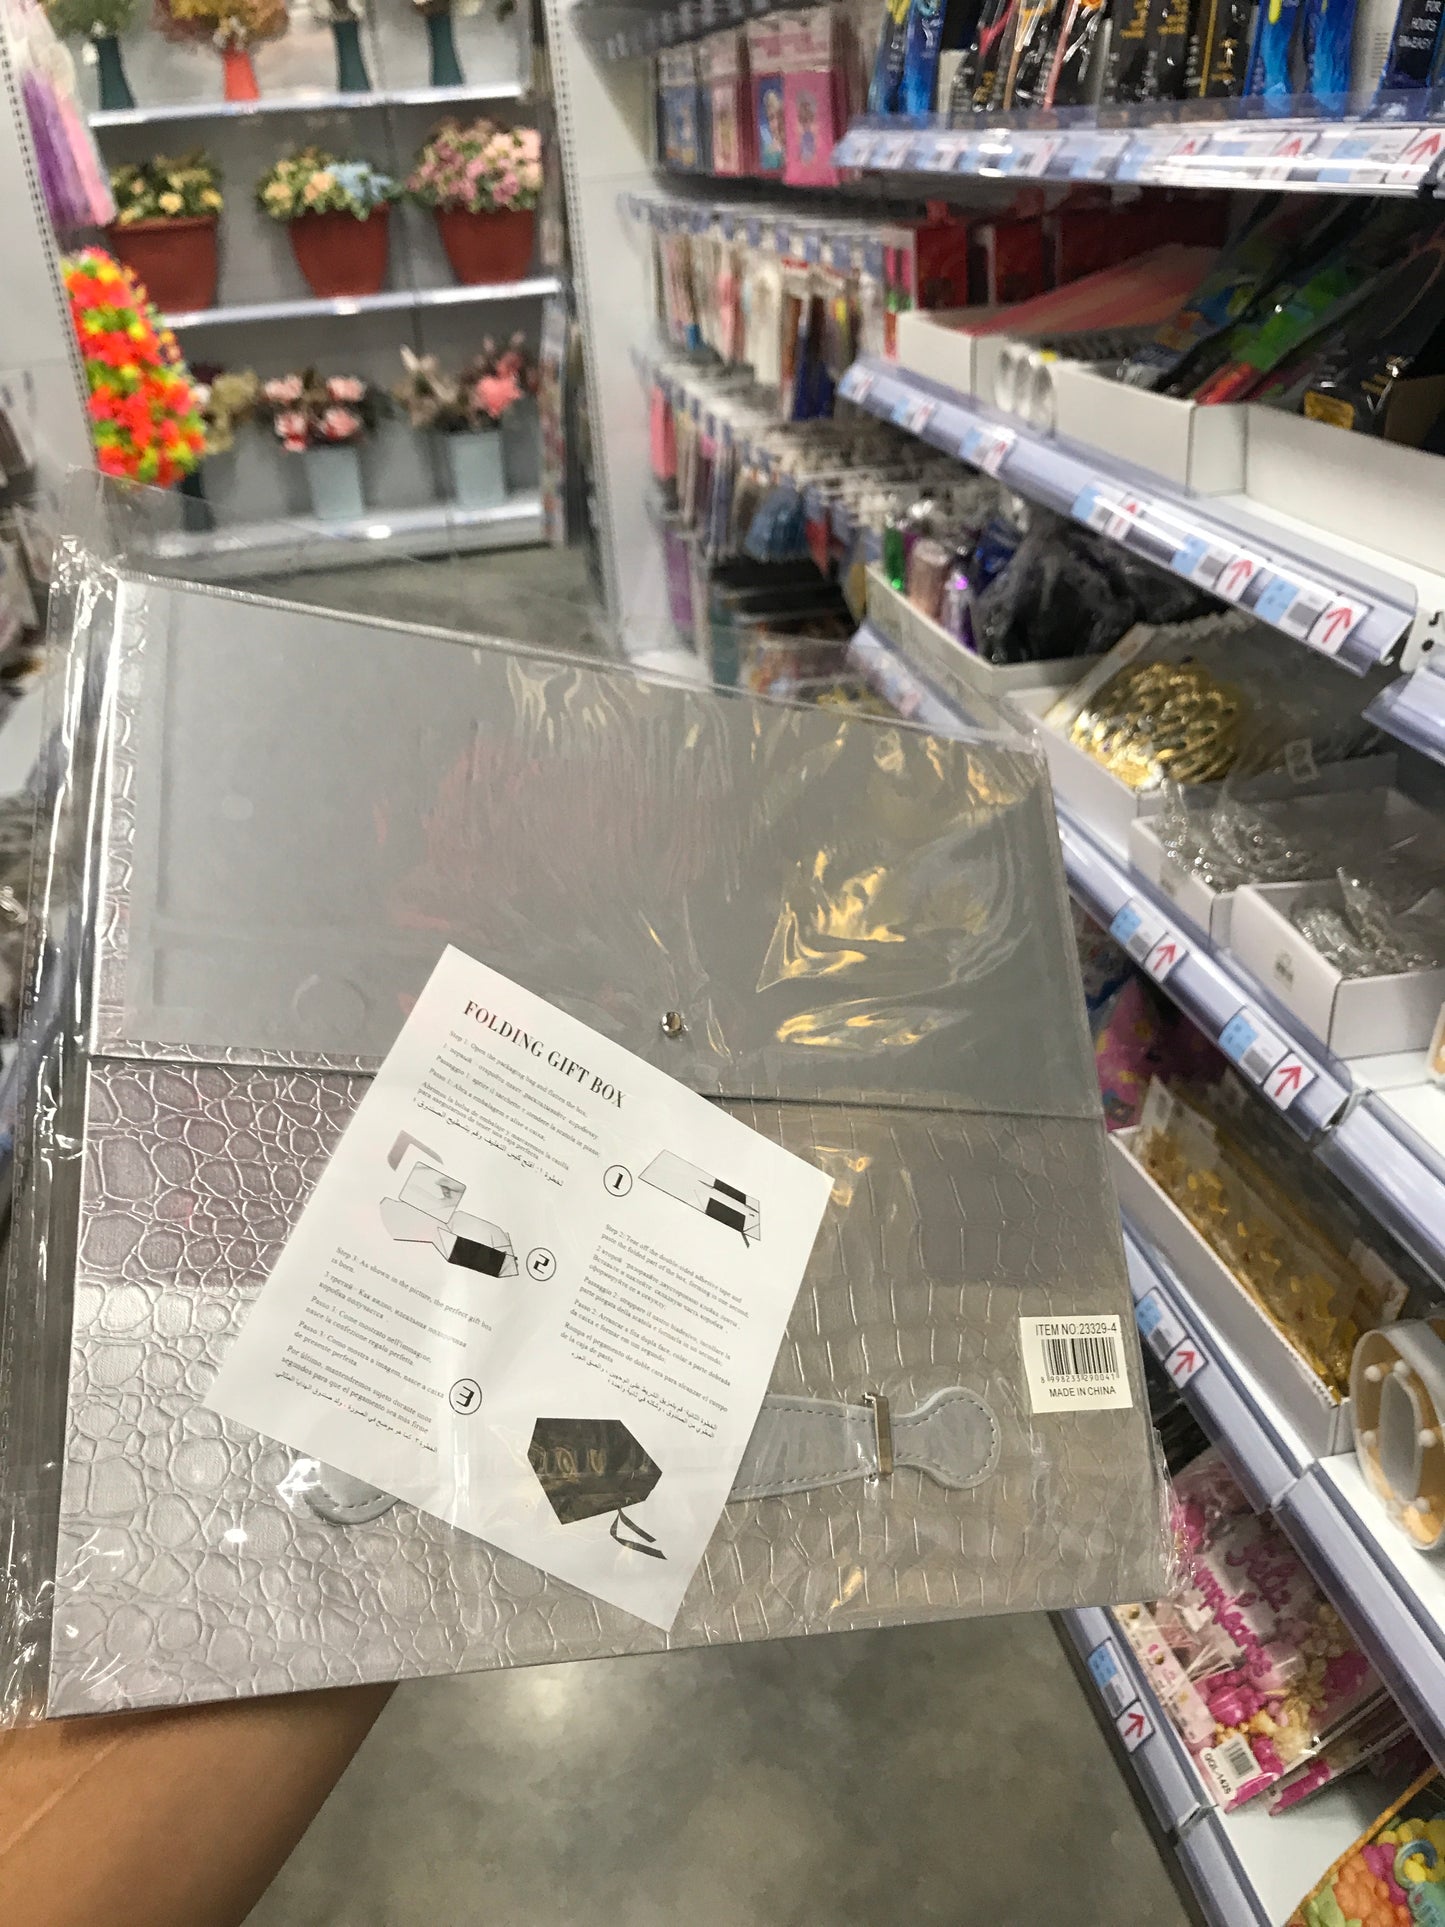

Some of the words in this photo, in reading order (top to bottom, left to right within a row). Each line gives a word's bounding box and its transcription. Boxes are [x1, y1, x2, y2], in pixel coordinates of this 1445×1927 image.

[464, 1000, 543, 1057] FOLDING
[547, 1050, 589, 1082] GIFT
[589, 1075, 626, 1109] BOX
[1035, 1324, 1059, 1336] ITEM
[1049, 1387, 1075, 1397] MADE
[1077, 1387, 1087, 1396] IN
[1087, 1385, 1117, 1396] CHINA
